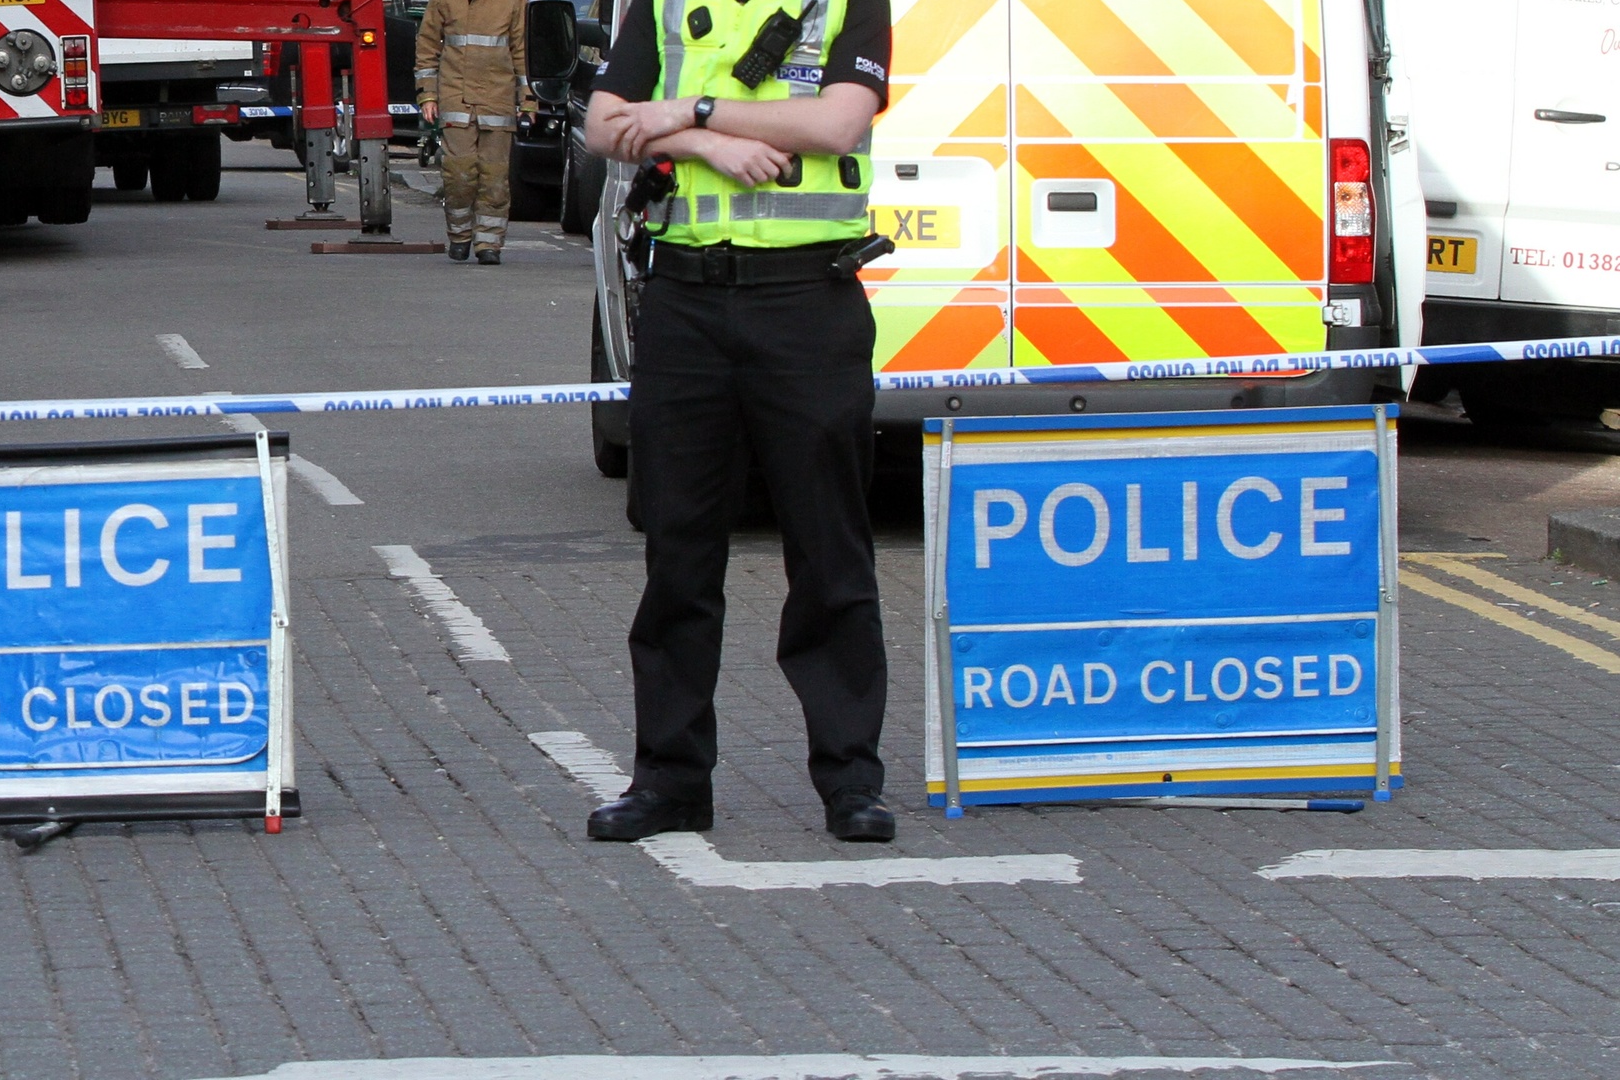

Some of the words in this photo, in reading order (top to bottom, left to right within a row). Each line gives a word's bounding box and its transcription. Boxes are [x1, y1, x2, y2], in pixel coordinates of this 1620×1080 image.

[101, 111, 129, 125] BYG
[870, 209, 937, 240] LXE
[1427, 238, 1465, 266] RT
[1510, 247, 1556, 267] TEL:
[973, 475, 1351, 569] POLICE
[963, 662, 1118, 709] ROAD
[1139, 653, 1362, 704] CLOSED
[21, 682, 255, 732] CLOSED
